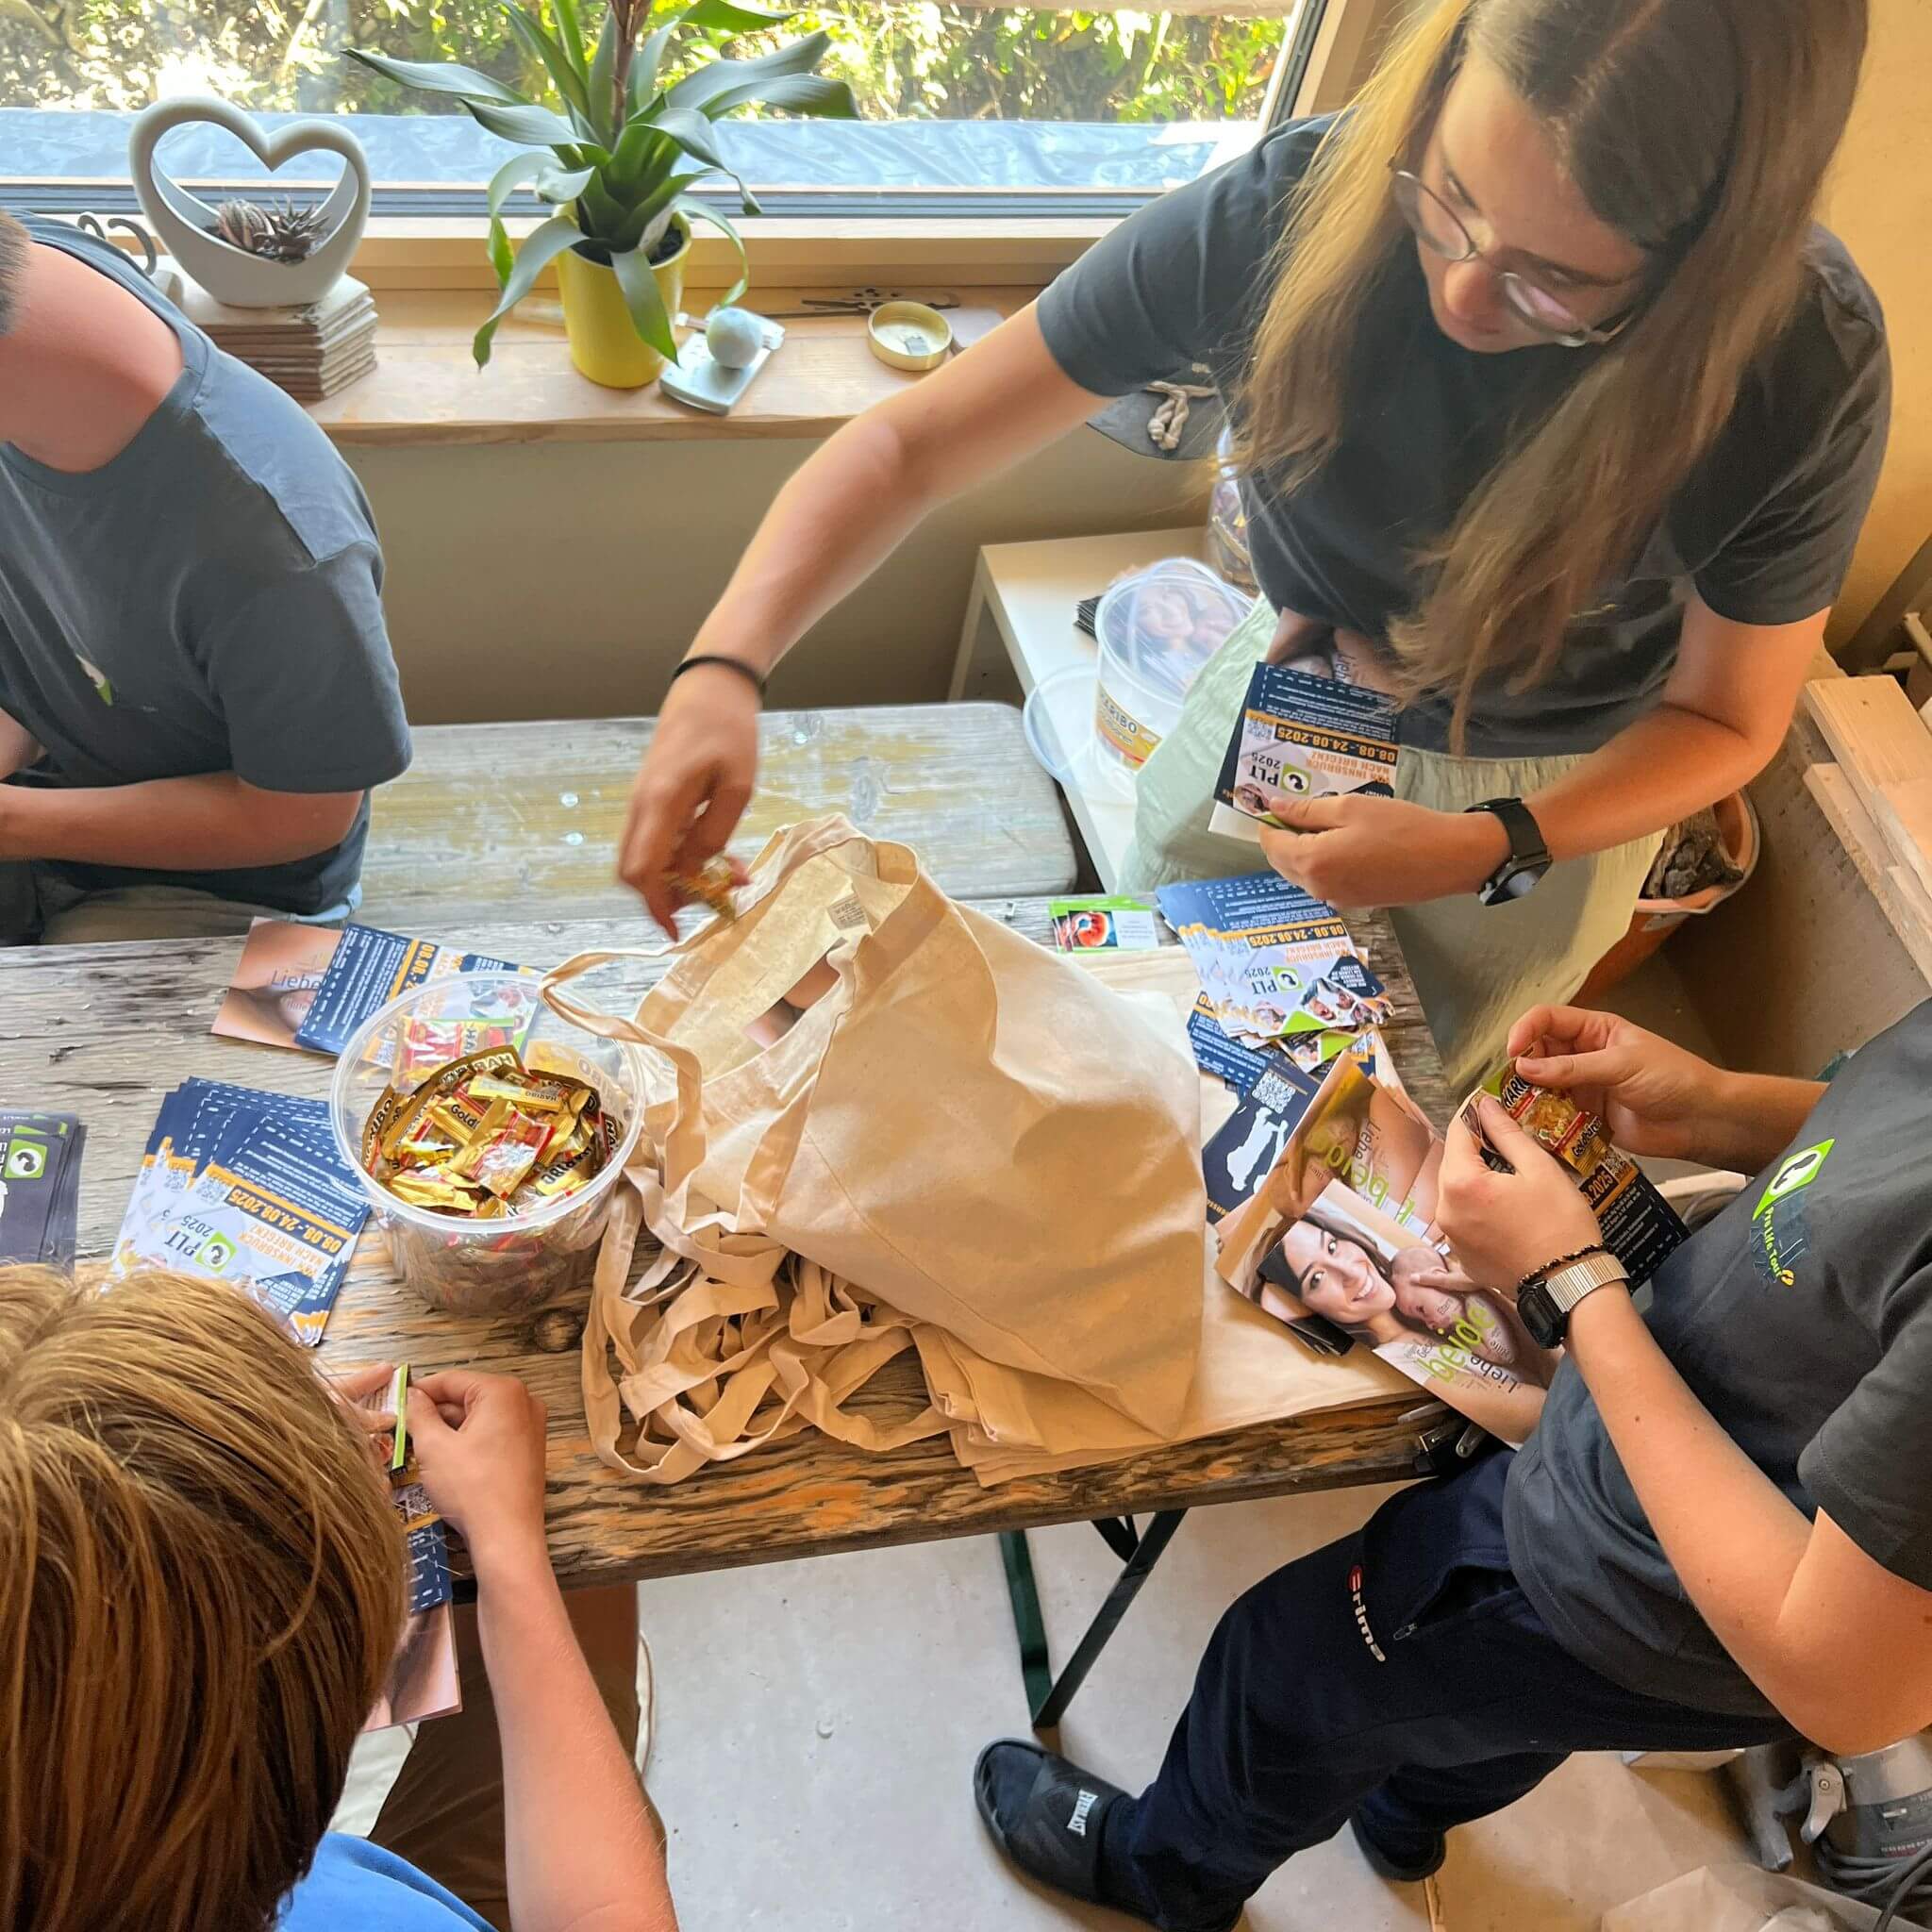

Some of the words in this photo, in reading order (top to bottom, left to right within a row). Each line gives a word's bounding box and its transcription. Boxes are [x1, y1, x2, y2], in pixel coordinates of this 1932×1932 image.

[1251, 751, 1281, 769] 2025
[1247, 764, 1278, 786] PLT
[1244, 966, 1271, 977] 2025
[1250, 979, 1276, 994] PLT
[179, 1214, 213, 1236] 2025
[163, 1228, 203, 1257] PLT
[1468, 1354, 1518, 1394] Liebe
